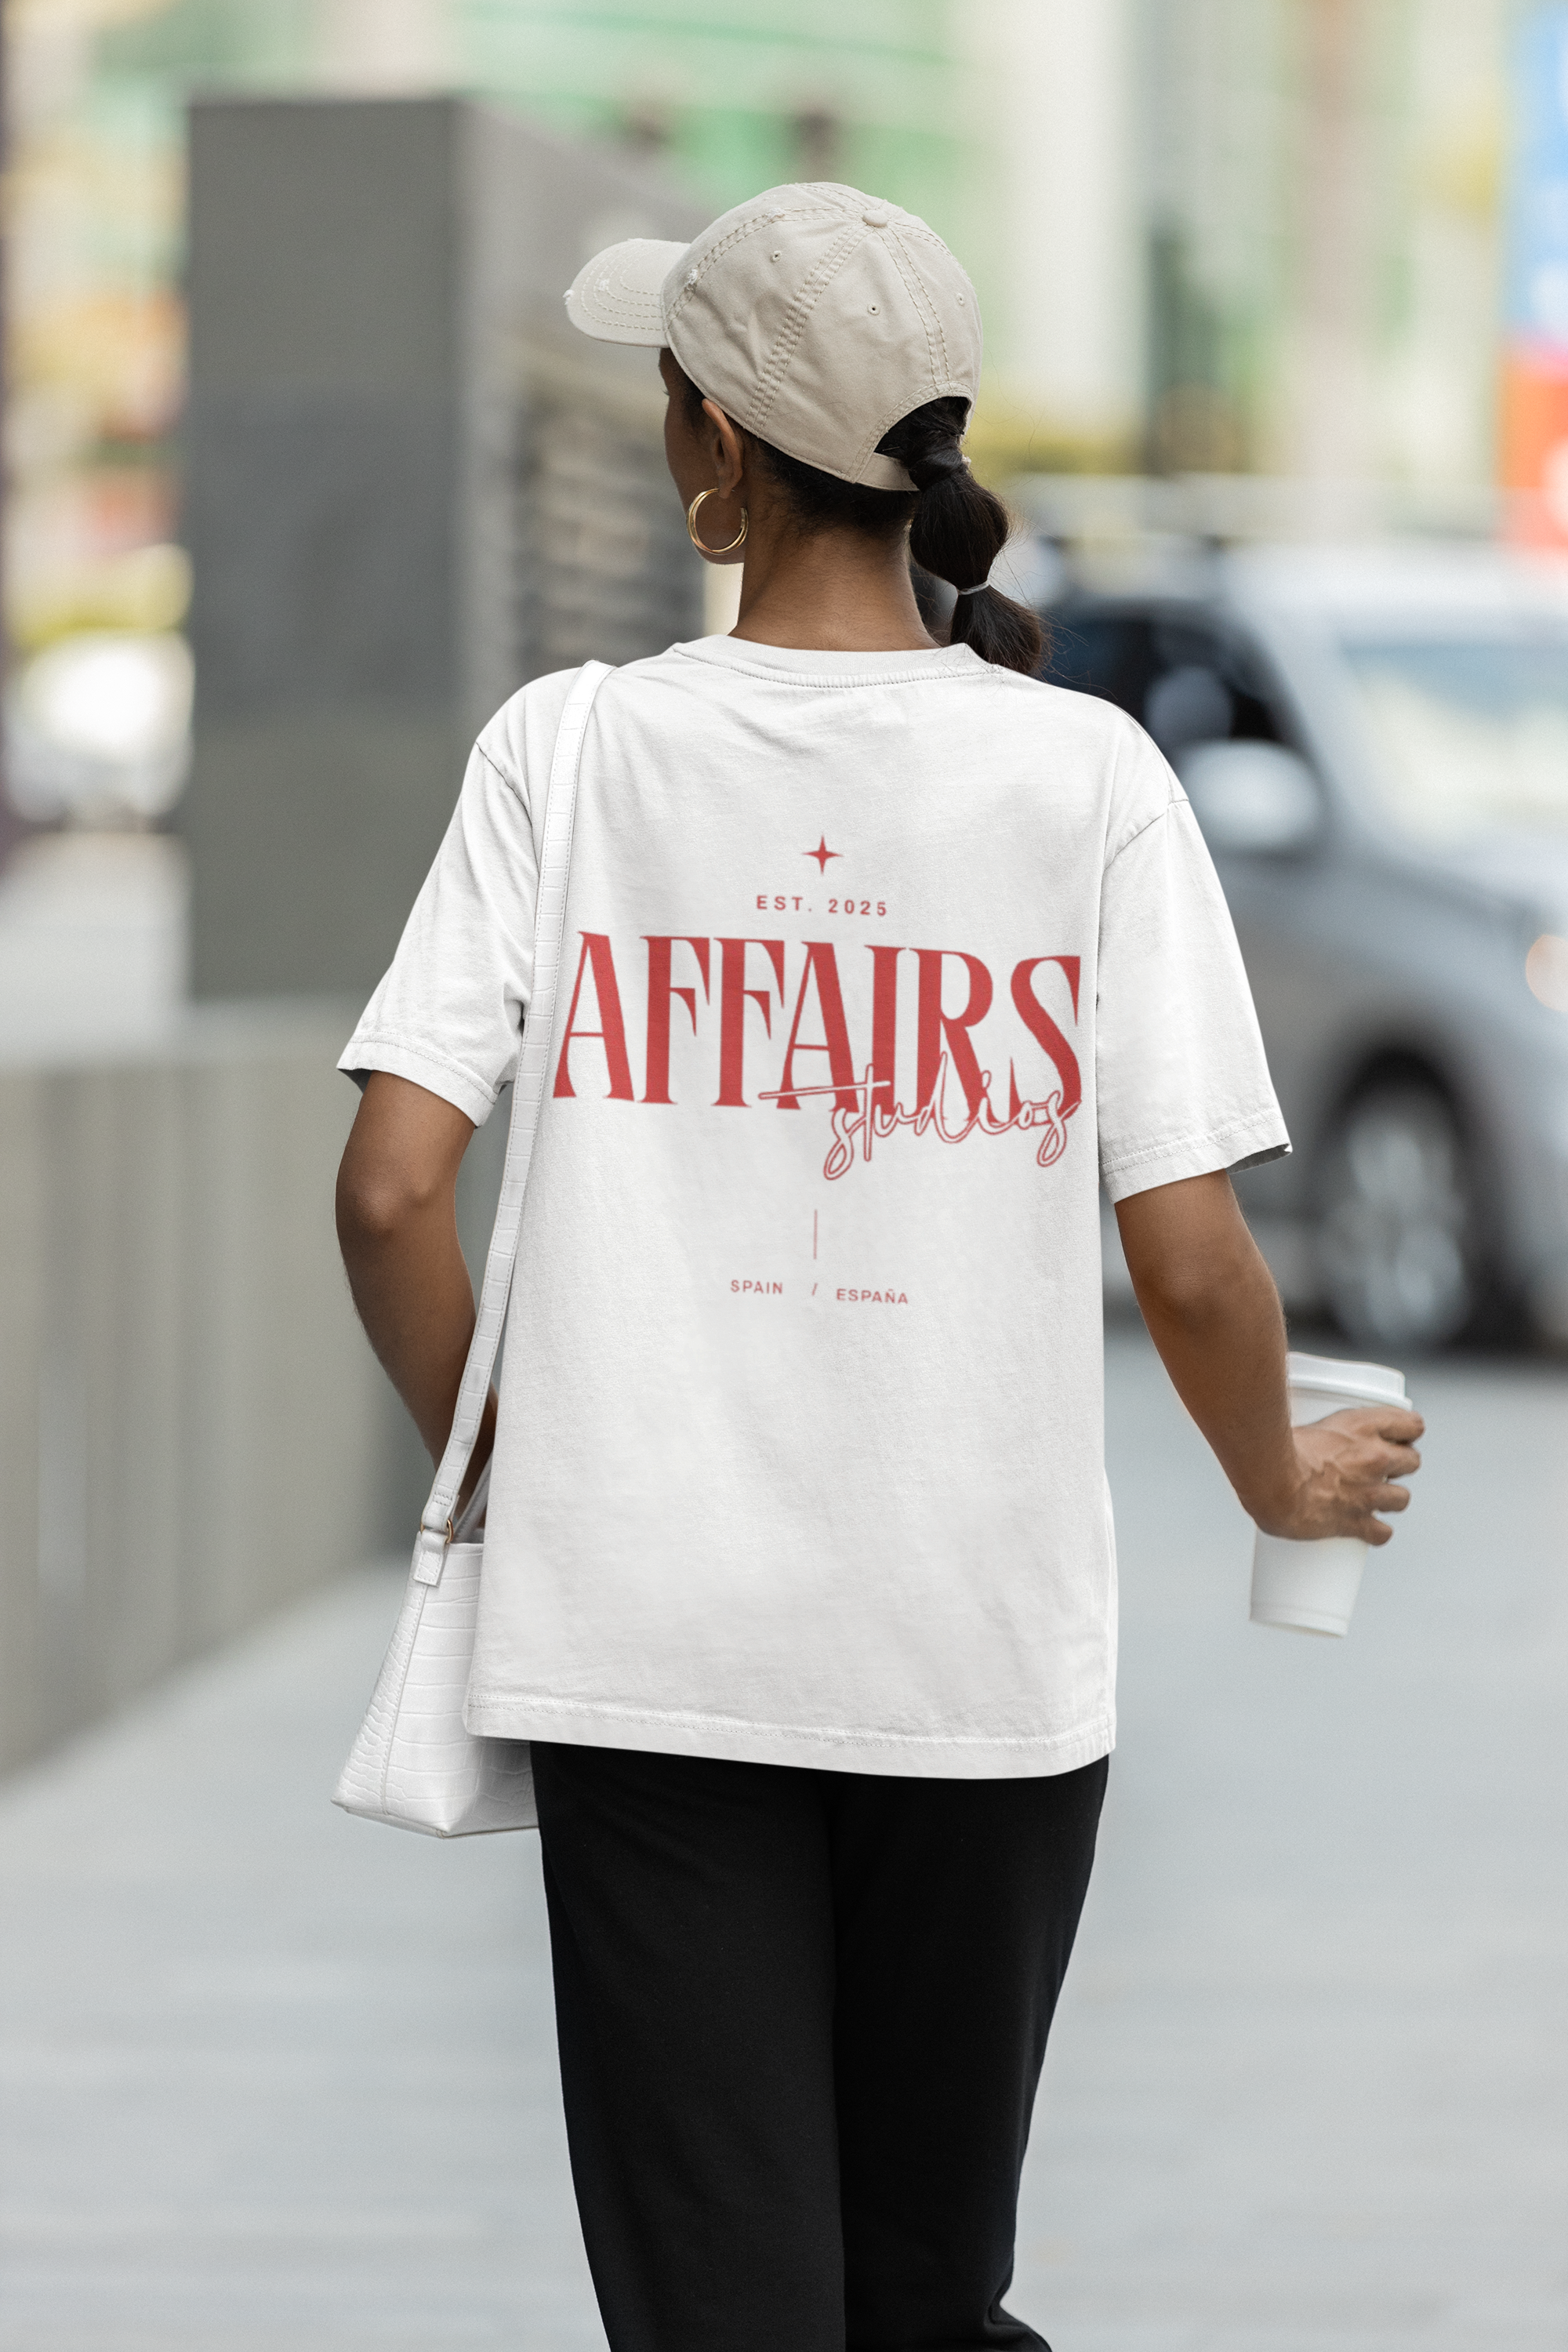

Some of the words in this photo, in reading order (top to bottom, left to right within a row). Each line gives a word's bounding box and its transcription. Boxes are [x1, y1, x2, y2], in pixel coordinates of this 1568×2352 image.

[756, 895, 813, 913] EST.
[828, 898, 888, 916] 2025
[552, 931, 1082, 1127] AFFAIRS
[758, 1051, 1083, 1181] studios
[730, 1279, 783, 1295] SPAIN
[836, 1287, 909, 1305] ESPAÑA
